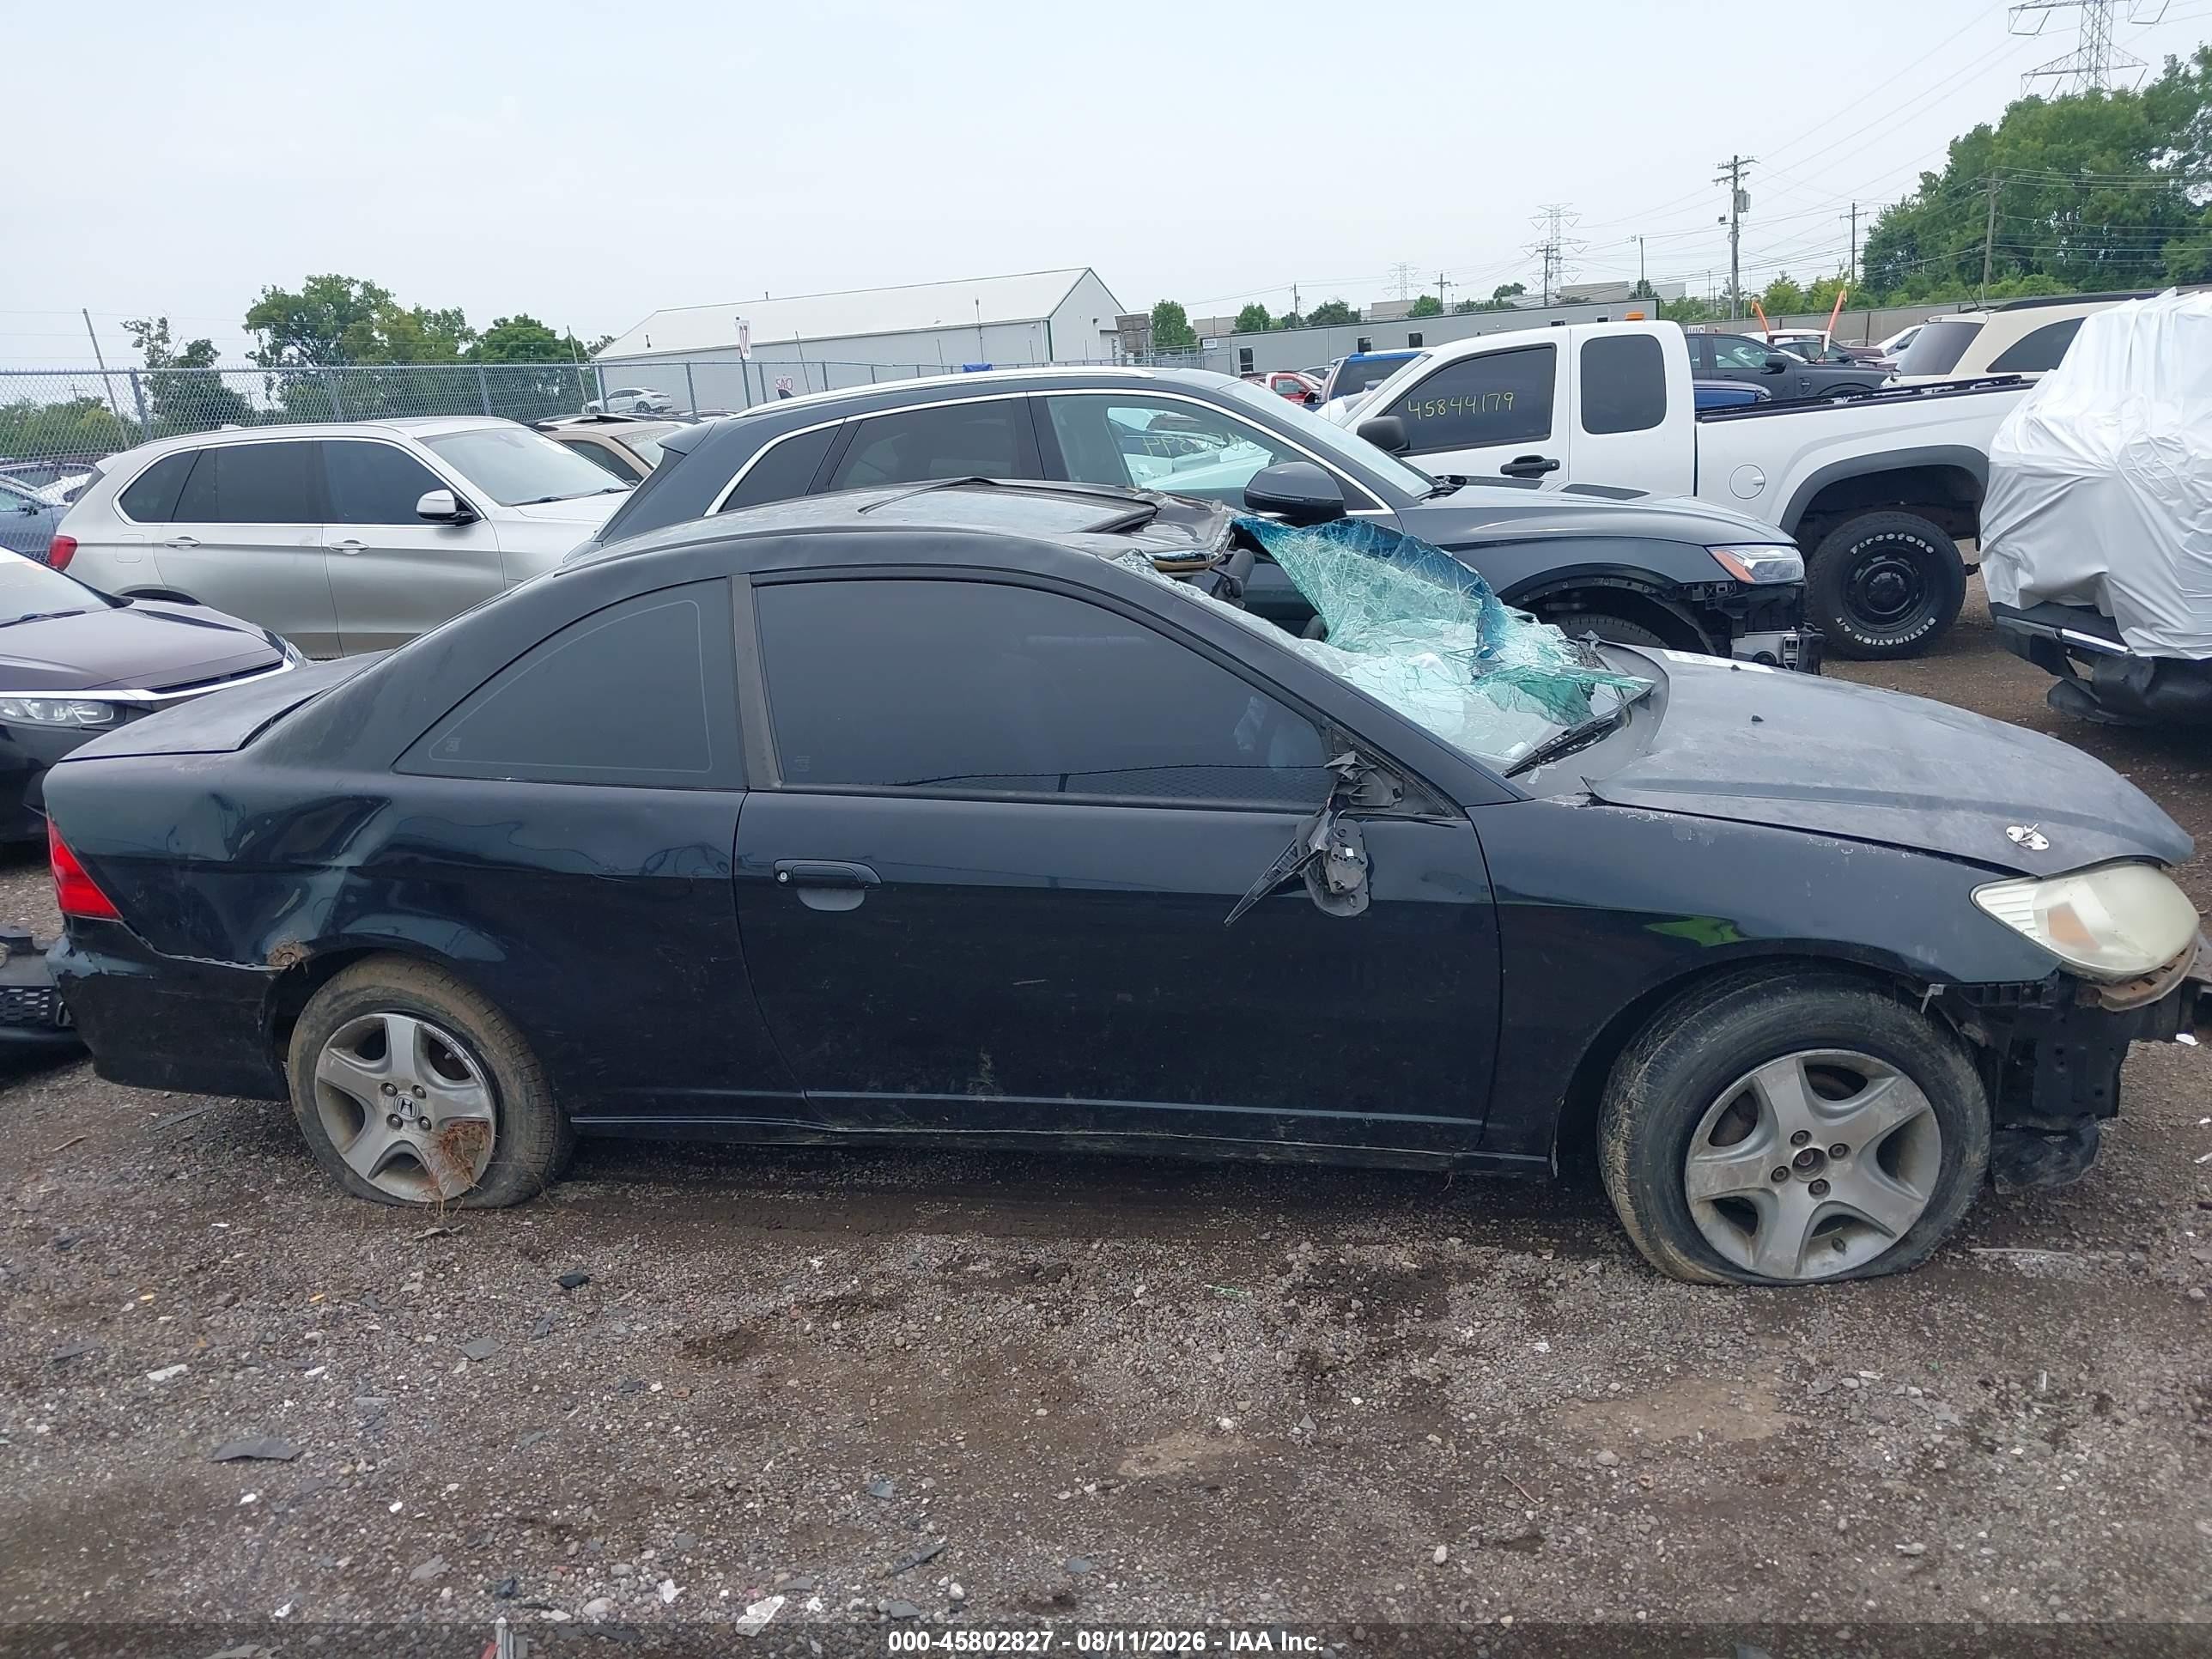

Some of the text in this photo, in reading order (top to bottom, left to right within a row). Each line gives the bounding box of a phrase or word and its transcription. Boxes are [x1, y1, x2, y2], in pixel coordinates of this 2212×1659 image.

[1407, 392, 1514, 420] 45844179
[1850, 532, 1935, 555] Firestone
[1834, 617, 1937, 646] DESTINATION A/T
